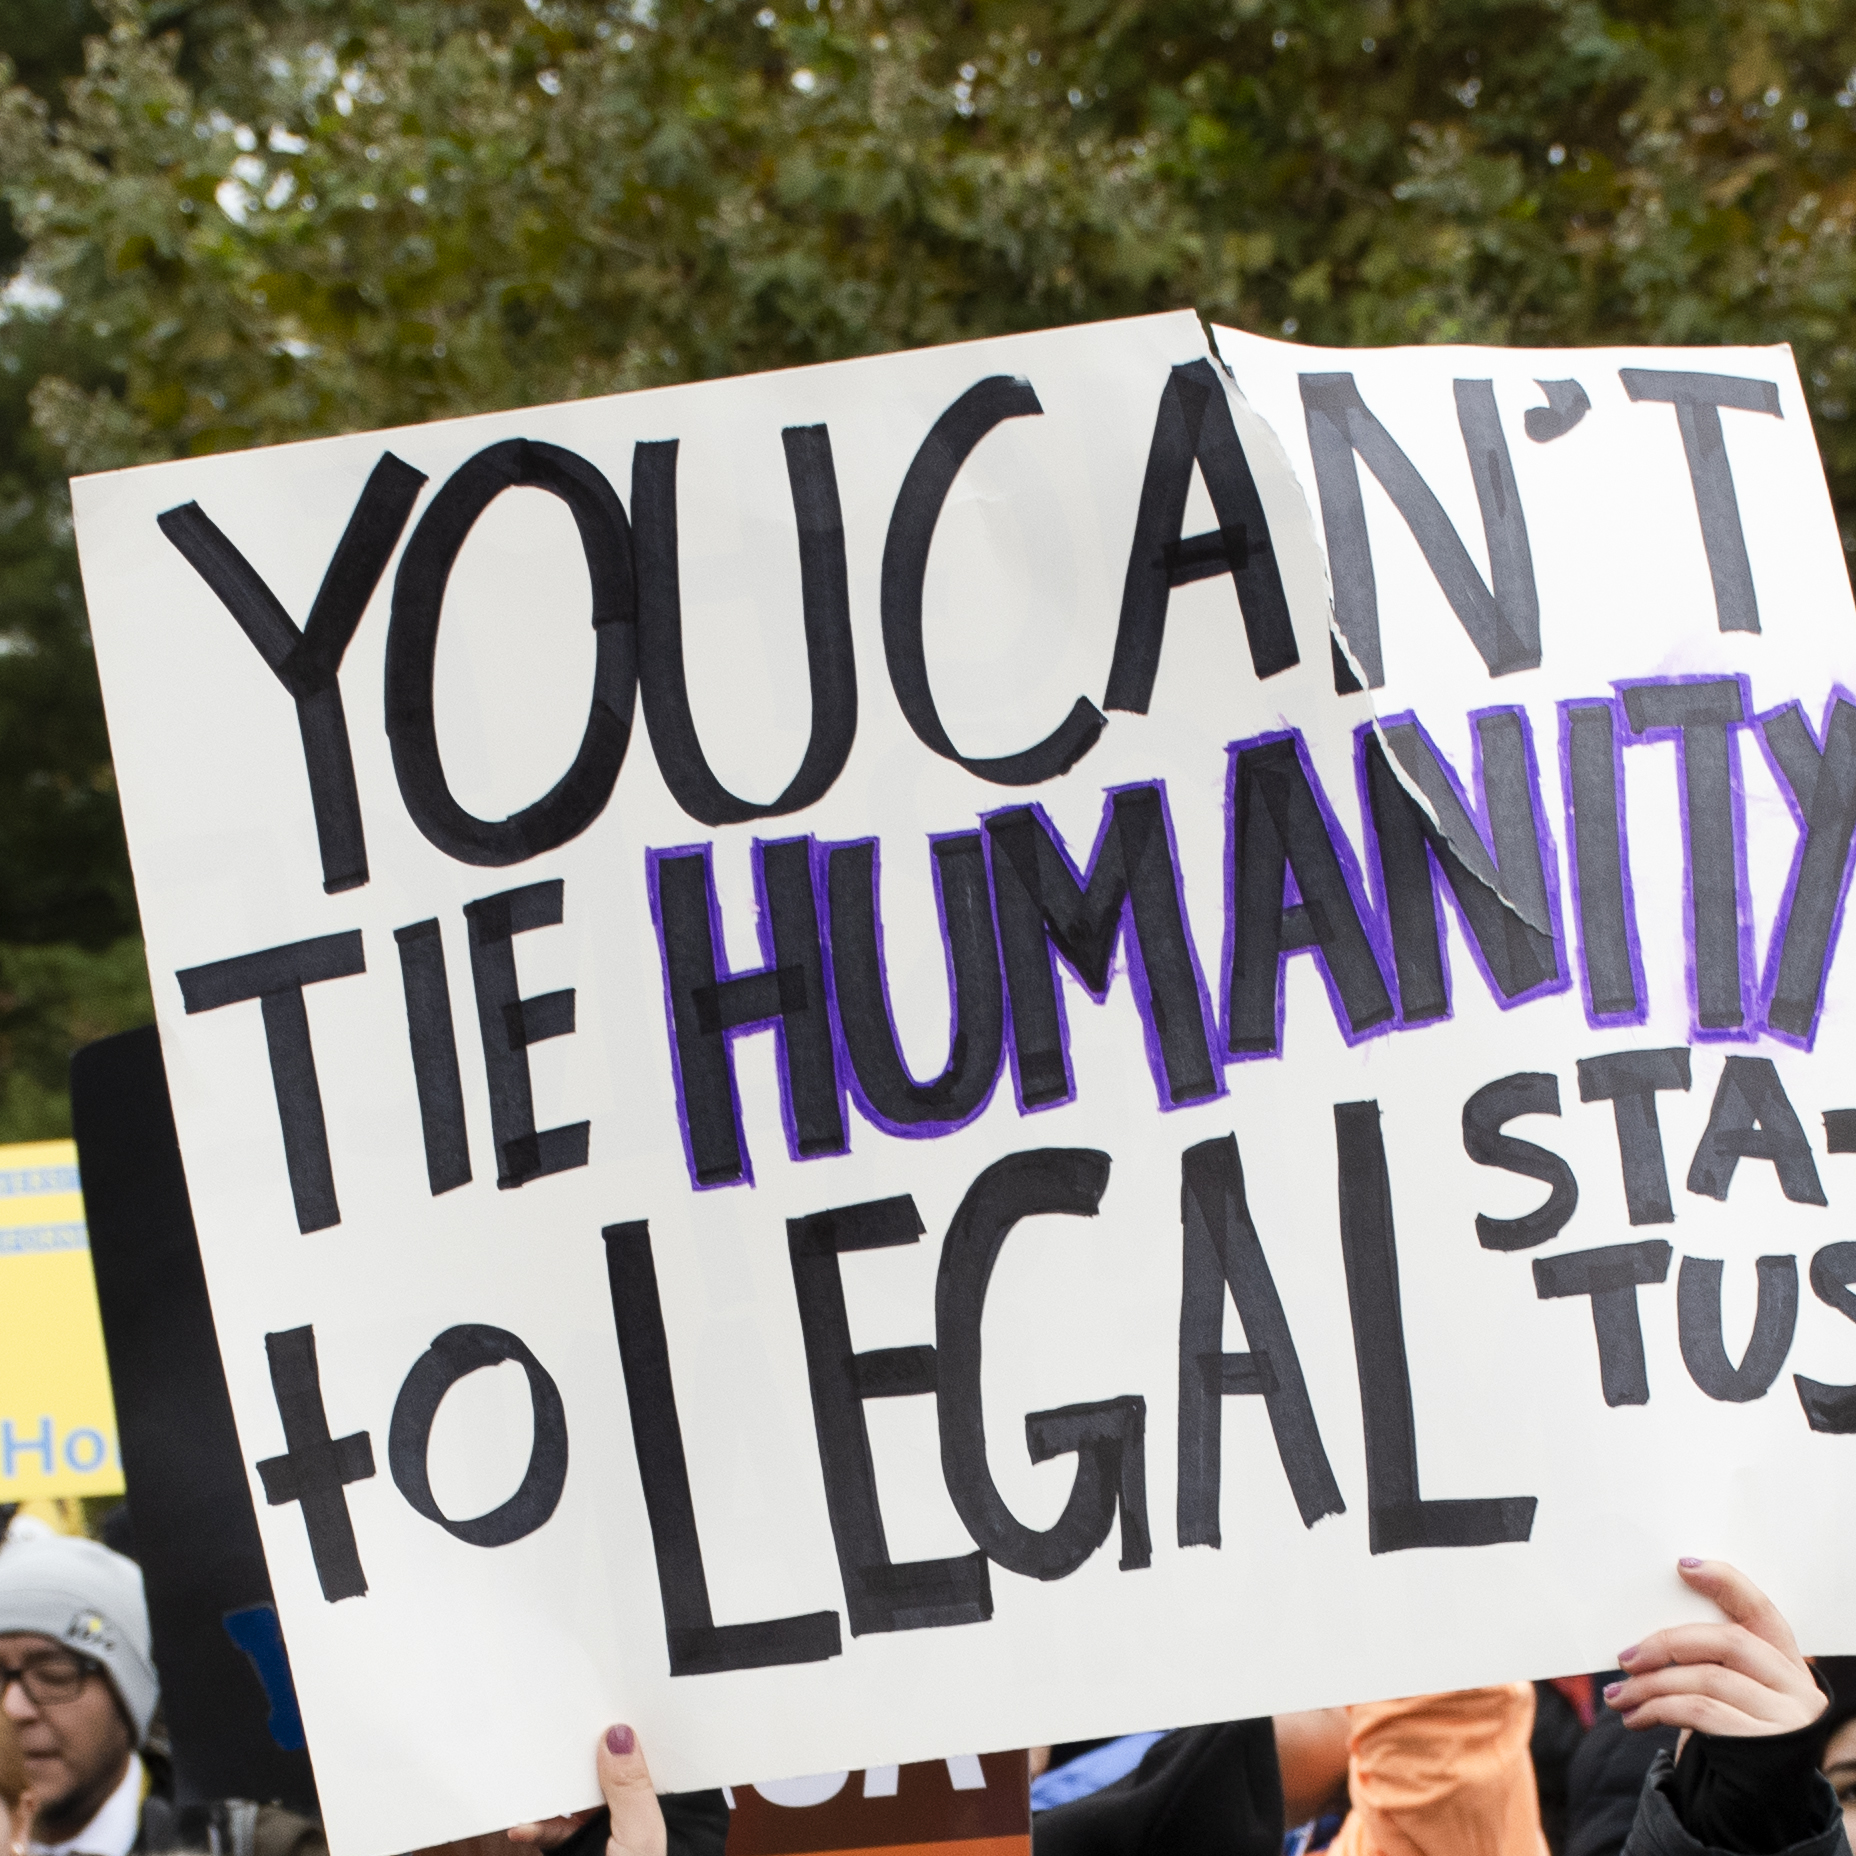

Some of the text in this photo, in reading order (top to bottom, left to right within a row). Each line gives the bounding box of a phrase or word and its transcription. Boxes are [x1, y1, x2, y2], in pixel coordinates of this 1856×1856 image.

[158, 361, 1784, 895] YOU CAN'T
[177, 879, 592, 1234] TIE
[602, 1100, 1539, 1675] LEGAL
